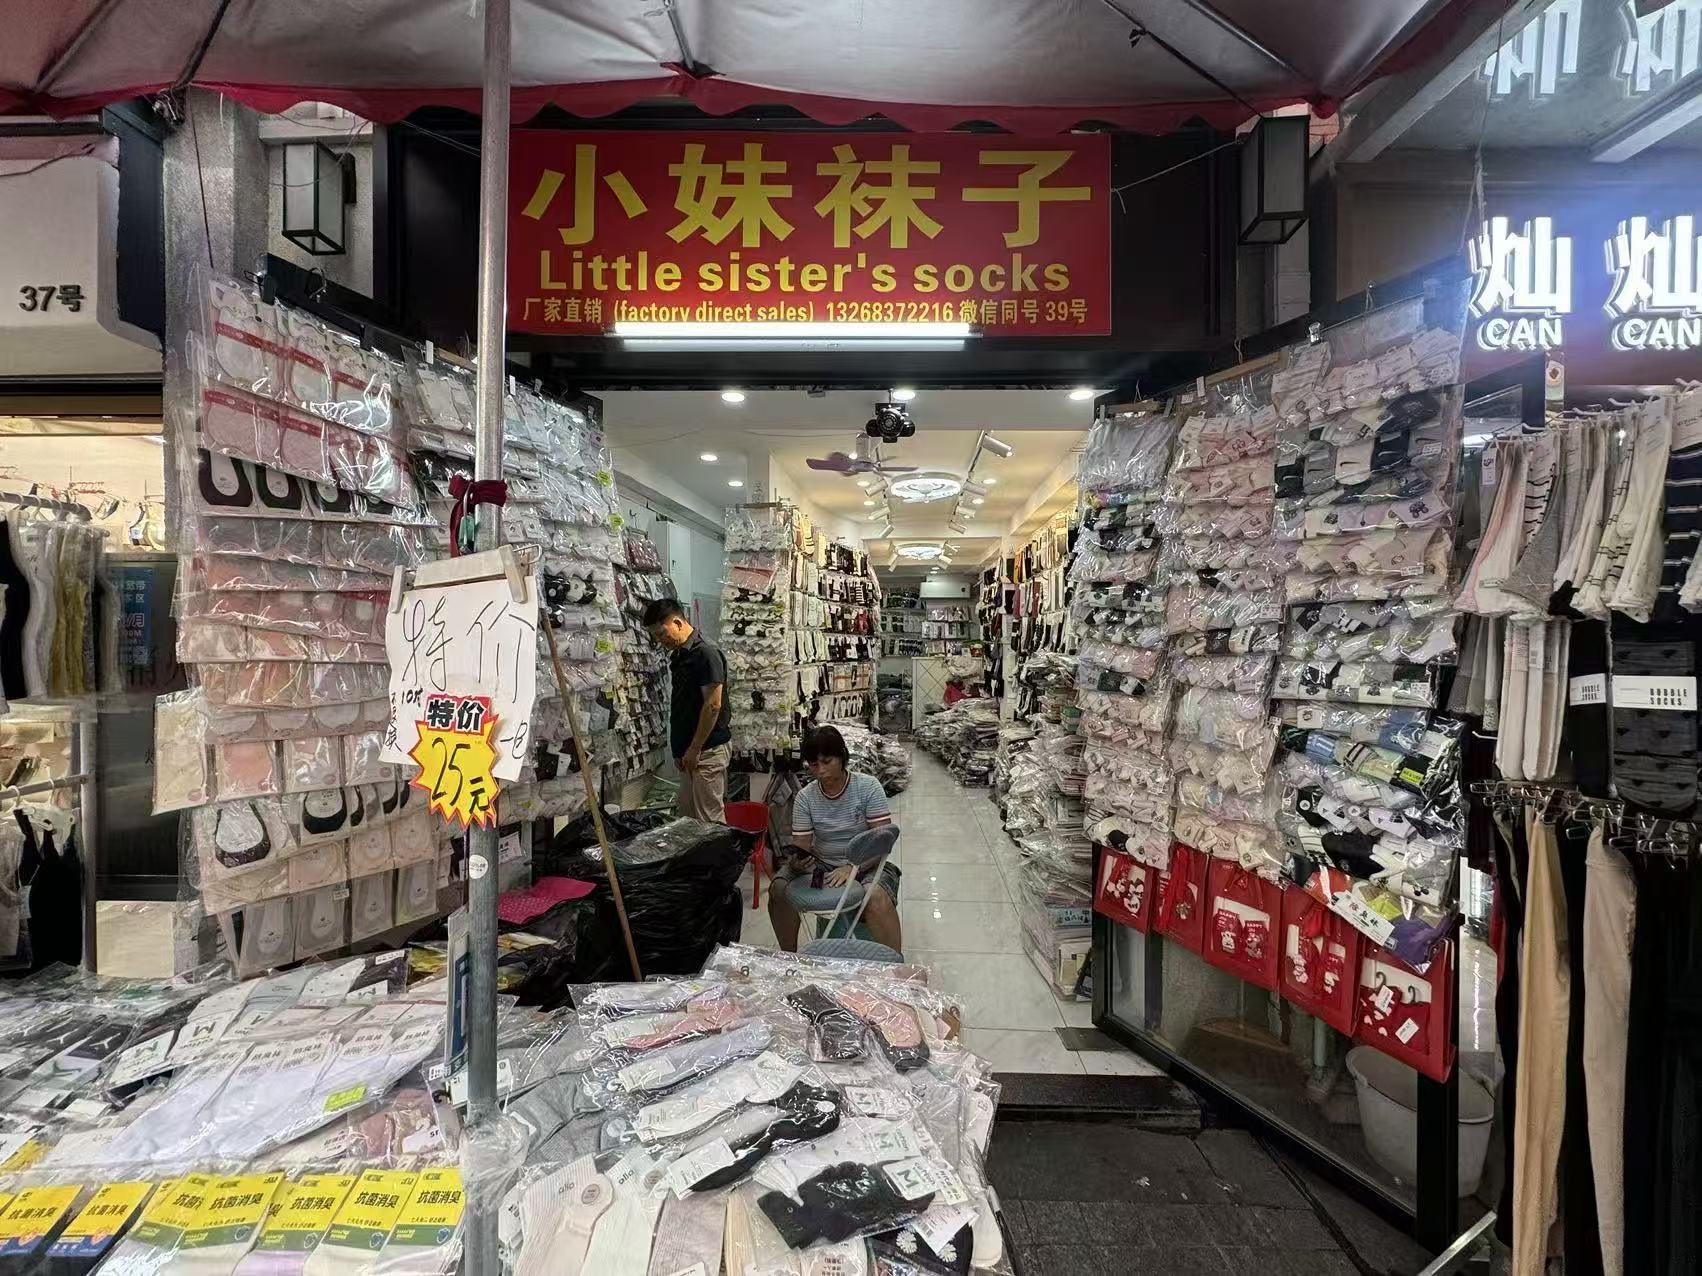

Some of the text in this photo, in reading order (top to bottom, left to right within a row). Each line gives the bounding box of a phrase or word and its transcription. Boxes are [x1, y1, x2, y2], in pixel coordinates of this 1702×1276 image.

[521, 143, 1092, 249] 小妹袜子
[540, 250, 1070, 293] Little sister's socks
[1469, 216, 1572, 317] 灿
[1605, 216, 1702, 317] 灿
[19, 284, 86, 312] 37号
[523, 297, 602, 324] 厂家直销
[695, 300, 752, 322] direct
[757, 300, 814, 322] sales)
[826, 301, 954, 322] 13268372216
[958, 299, 1040, 325] 微信同号
[1045, 299, 1088, 324] 39号
[1481, 317, 1563, 349] CAN
[1615, 317, 1702, 349] CAN
[401, 595, 536, 704] 特价
[426, 699, 485, 731] 特价
[208, 1192, 264, 1211] 抗菌消臭
[289, 1196, 336, 1211] 抗菌消臭
[354, 1191, 401, 1209] 抗菌消臭
[416, 1190, 462, 1205] 抗菌消臭
